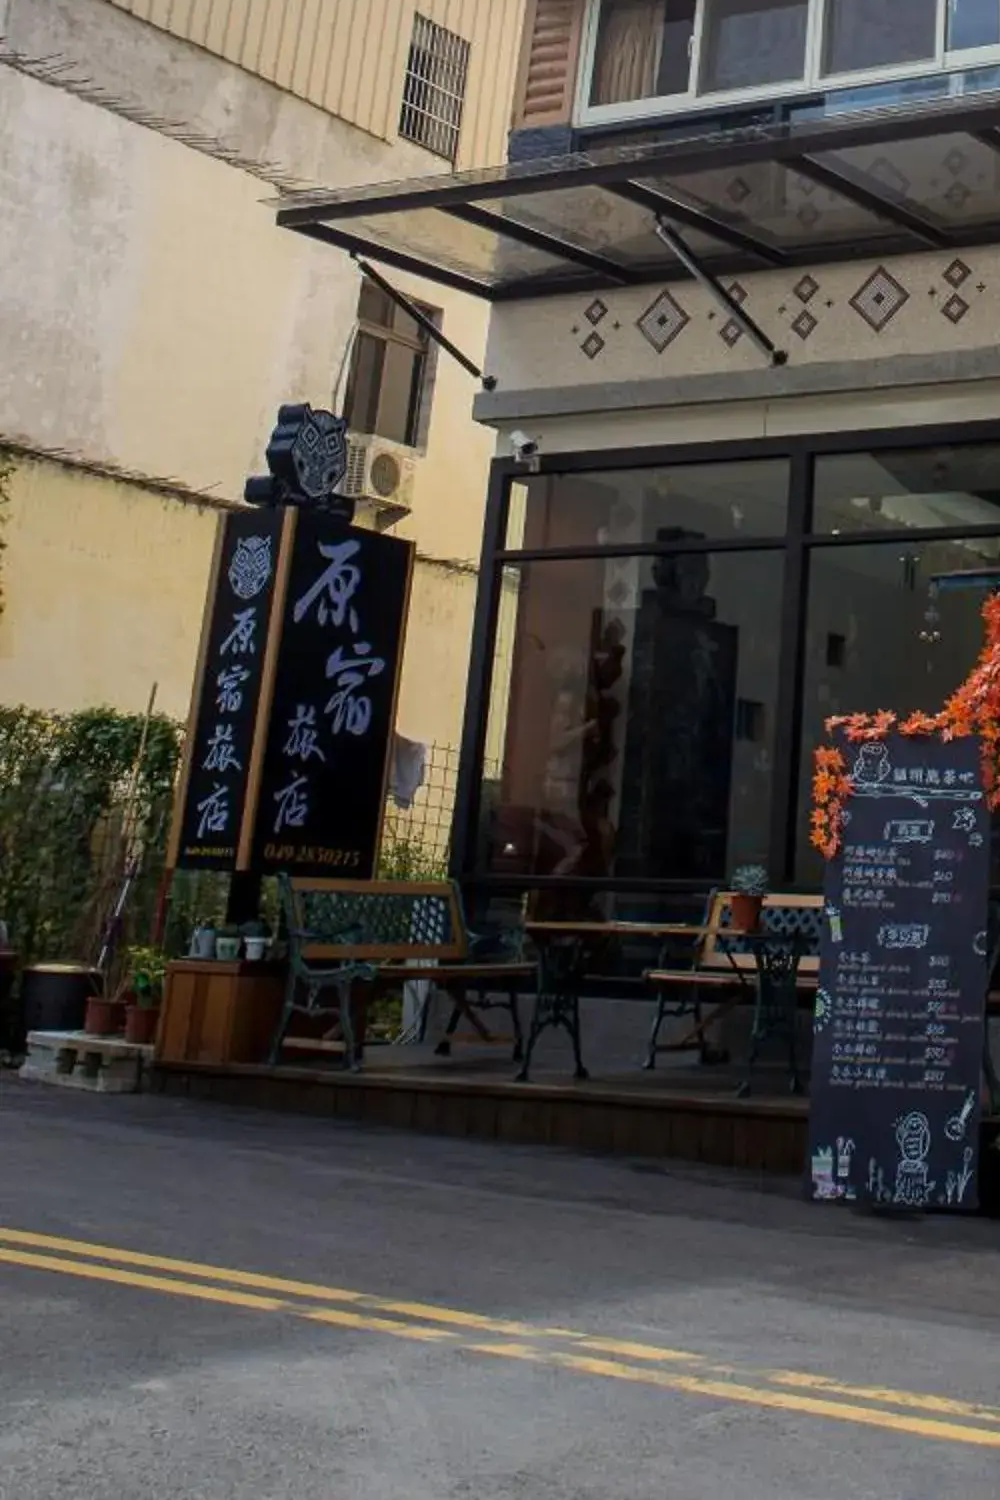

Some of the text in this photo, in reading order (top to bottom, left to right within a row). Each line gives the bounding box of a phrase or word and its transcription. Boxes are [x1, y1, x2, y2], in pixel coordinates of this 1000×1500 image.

[196, 607, 256, 839] 原宿旅店
[272, 703, 326, 835] 旅店
